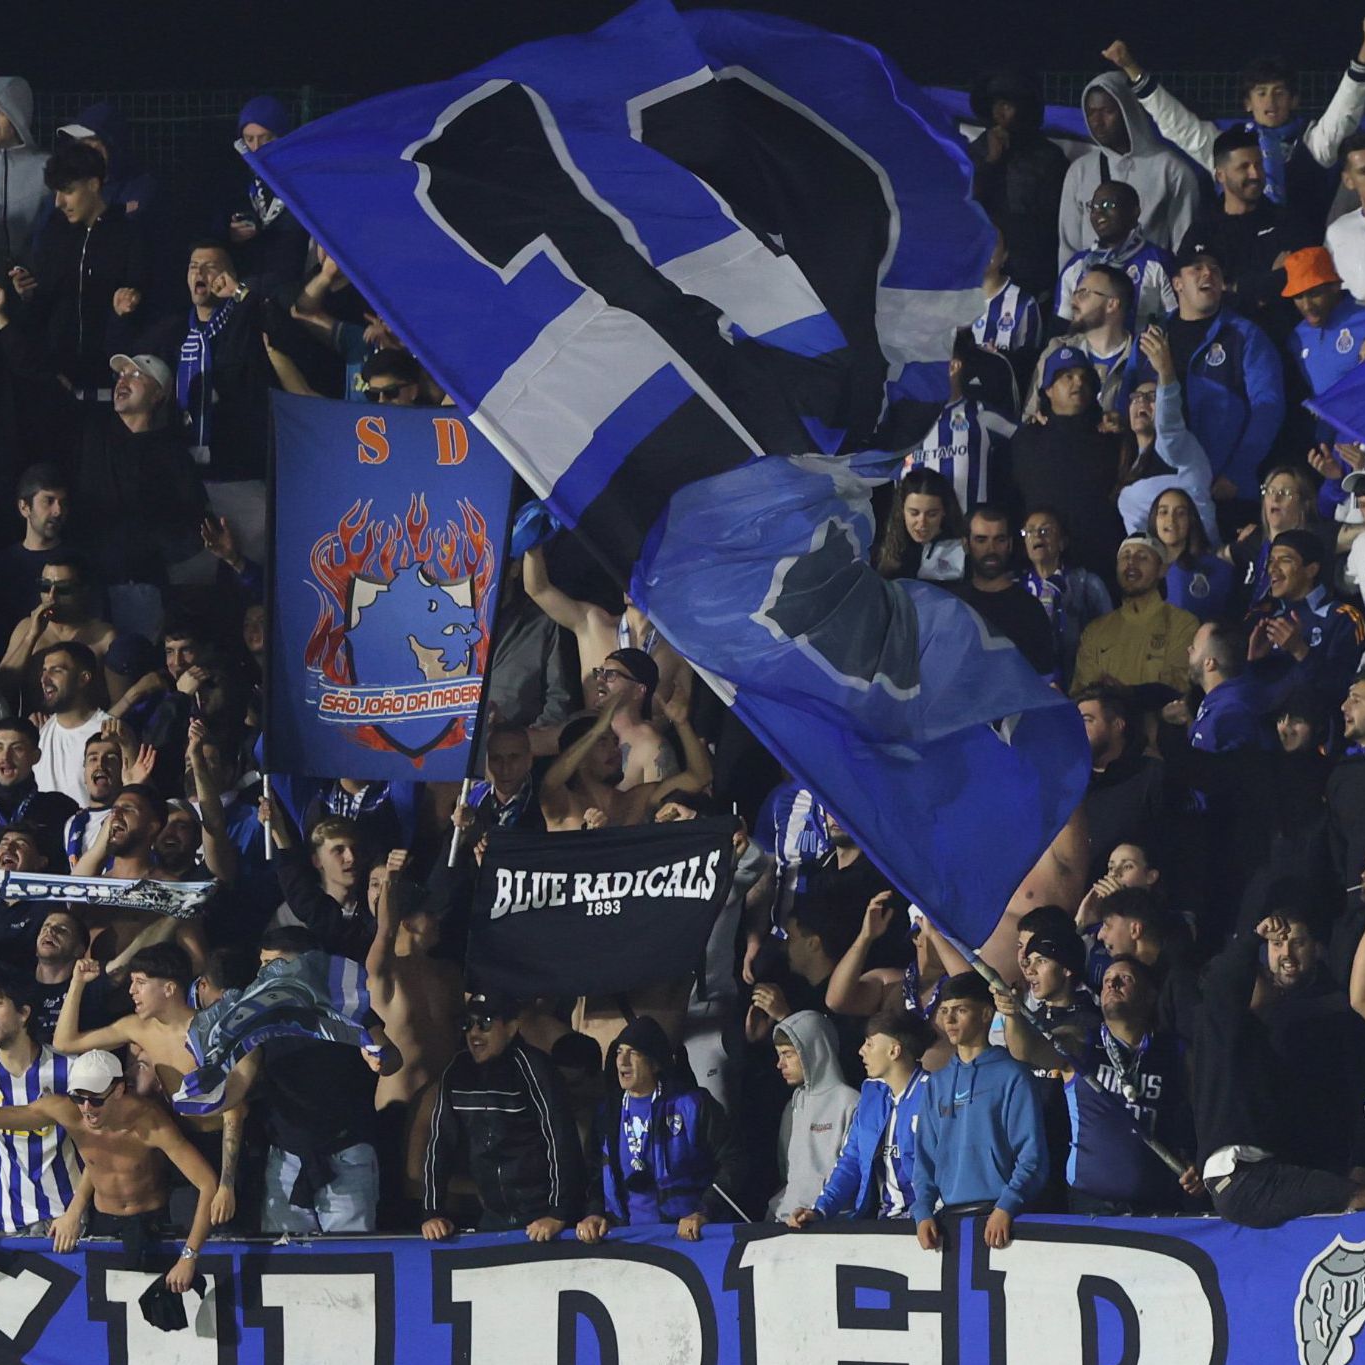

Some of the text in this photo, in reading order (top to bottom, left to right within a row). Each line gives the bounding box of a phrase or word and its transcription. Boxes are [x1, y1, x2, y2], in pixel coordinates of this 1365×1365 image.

[408, 692, 431, 713] DA
[490, 850, 721, 920] BLUE RADICALS
[585, 899, 621, 917] 1893
